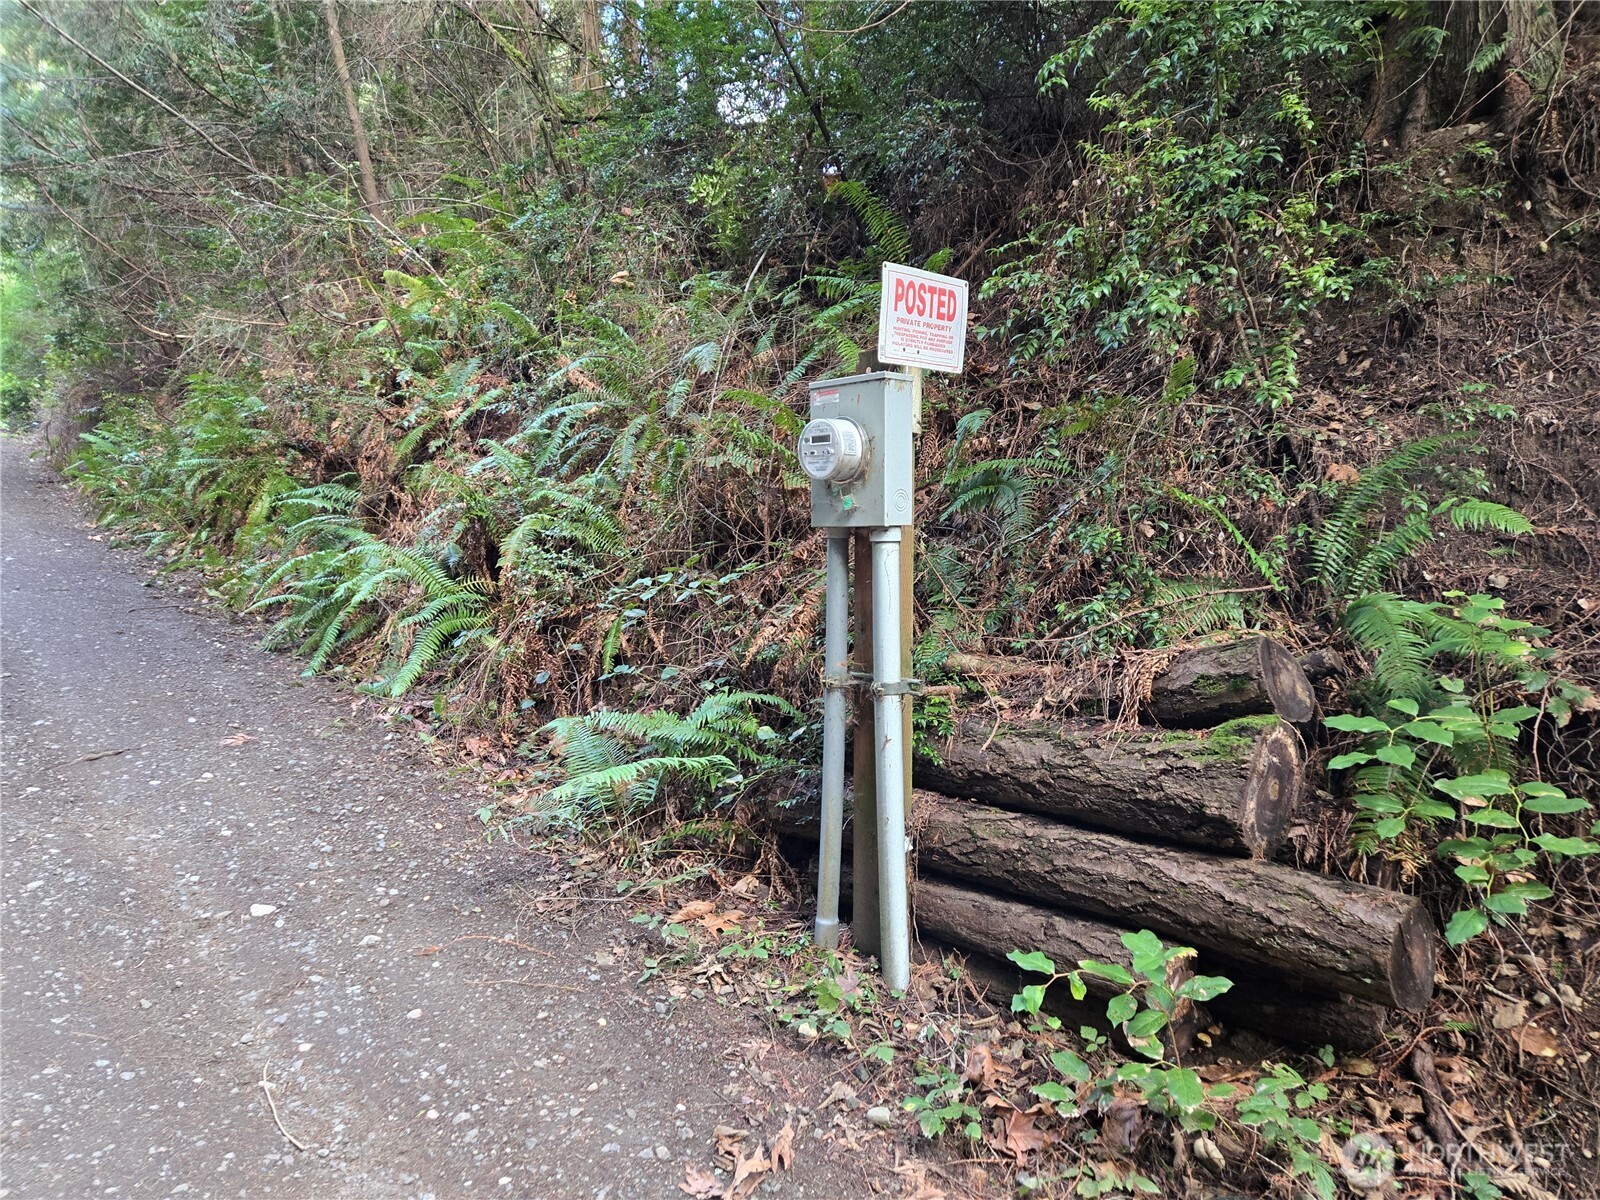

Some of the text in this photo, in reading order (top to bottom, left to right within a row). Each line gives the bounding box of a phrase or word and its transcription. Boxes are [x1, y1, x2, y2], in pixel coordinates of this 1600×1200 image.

[894, 278, 957, 322] POSTED
[896, 316, 952, 332] PRIVATE PROPERTY
[894, 331, 920, 339] TRESPASSING
